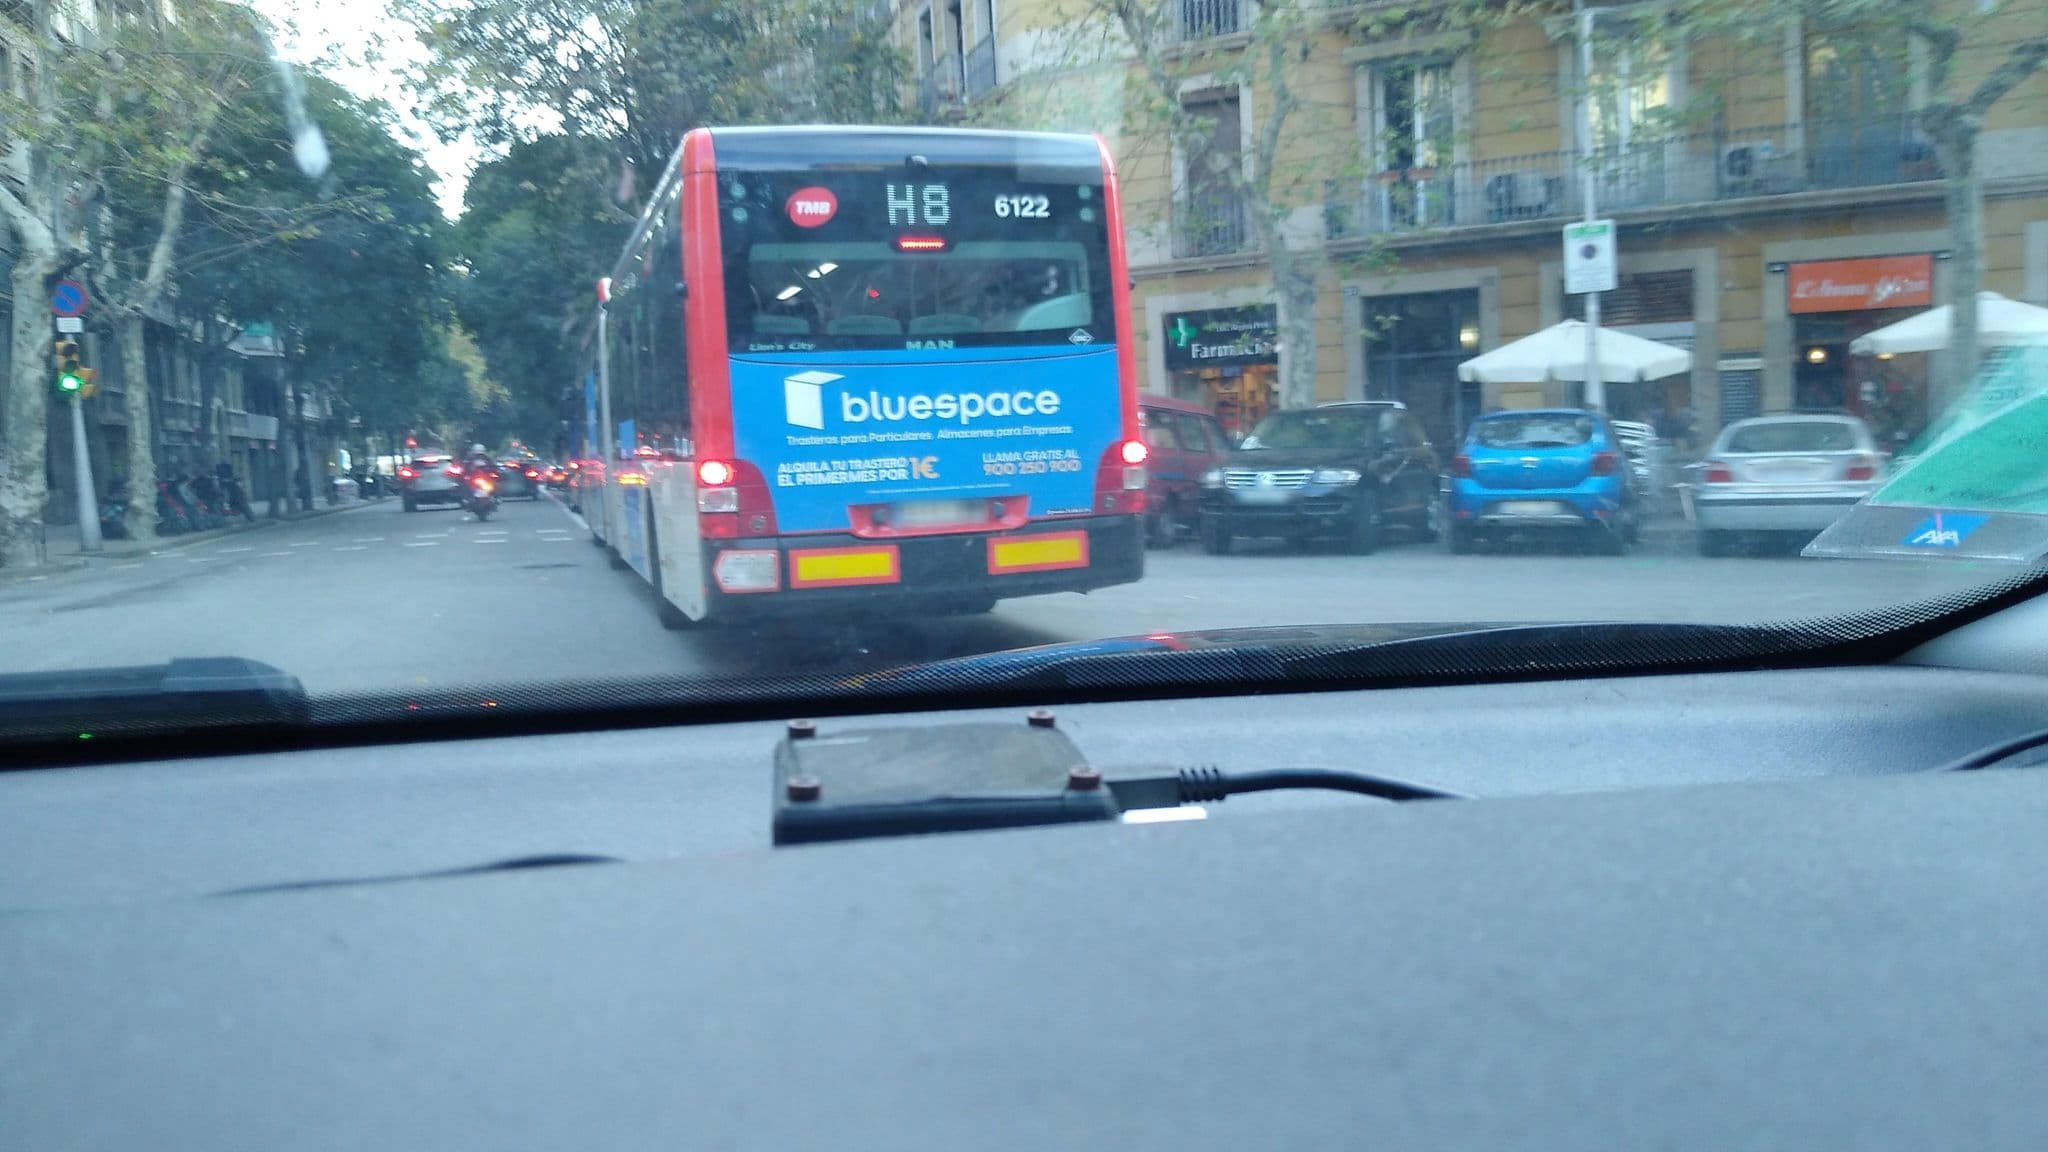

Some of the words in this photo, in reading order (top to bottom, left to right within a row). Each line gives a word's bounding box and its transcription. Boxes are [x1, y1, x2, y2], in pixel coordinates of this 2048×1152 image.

[795, 201, 831, 216] TMB
[886, 184, 952, 226] H8
[994, 195, 1050, 218] 6122
[906, 340, 954, 350] MAN
[841, 389, 1061, 424] bluespace
[786, 435, 838, 445] Trasteros
[840, 434, 866, 444] para
[937, 428, 993, 439] Almacenes
[996, 428, 1022, 438] para
[1022, 425, 1073, 436] Empresas
[777, 461, 830, 474] ALQUILA
[831, 460, 847, 471] TU
[848, 457, 908, 471] TRASTERO
[982, 452, 1021, 463] LLAMA
[1023, 450, 1063, 462] GRATIS
[1063, 449, 1080, 459] AL
[908, 455, 941, 480] 1€
[983, 463, 1016, 476] 900
[1018, 461, 1048, 474] 250
[1049, 459, 1082, 472] 900
[777, 474, 794, 487] EL
[796, 470, 851, 485] PRIMER
[850, 470, 878, 483] MES
[879, 468, 908, 481] POR
